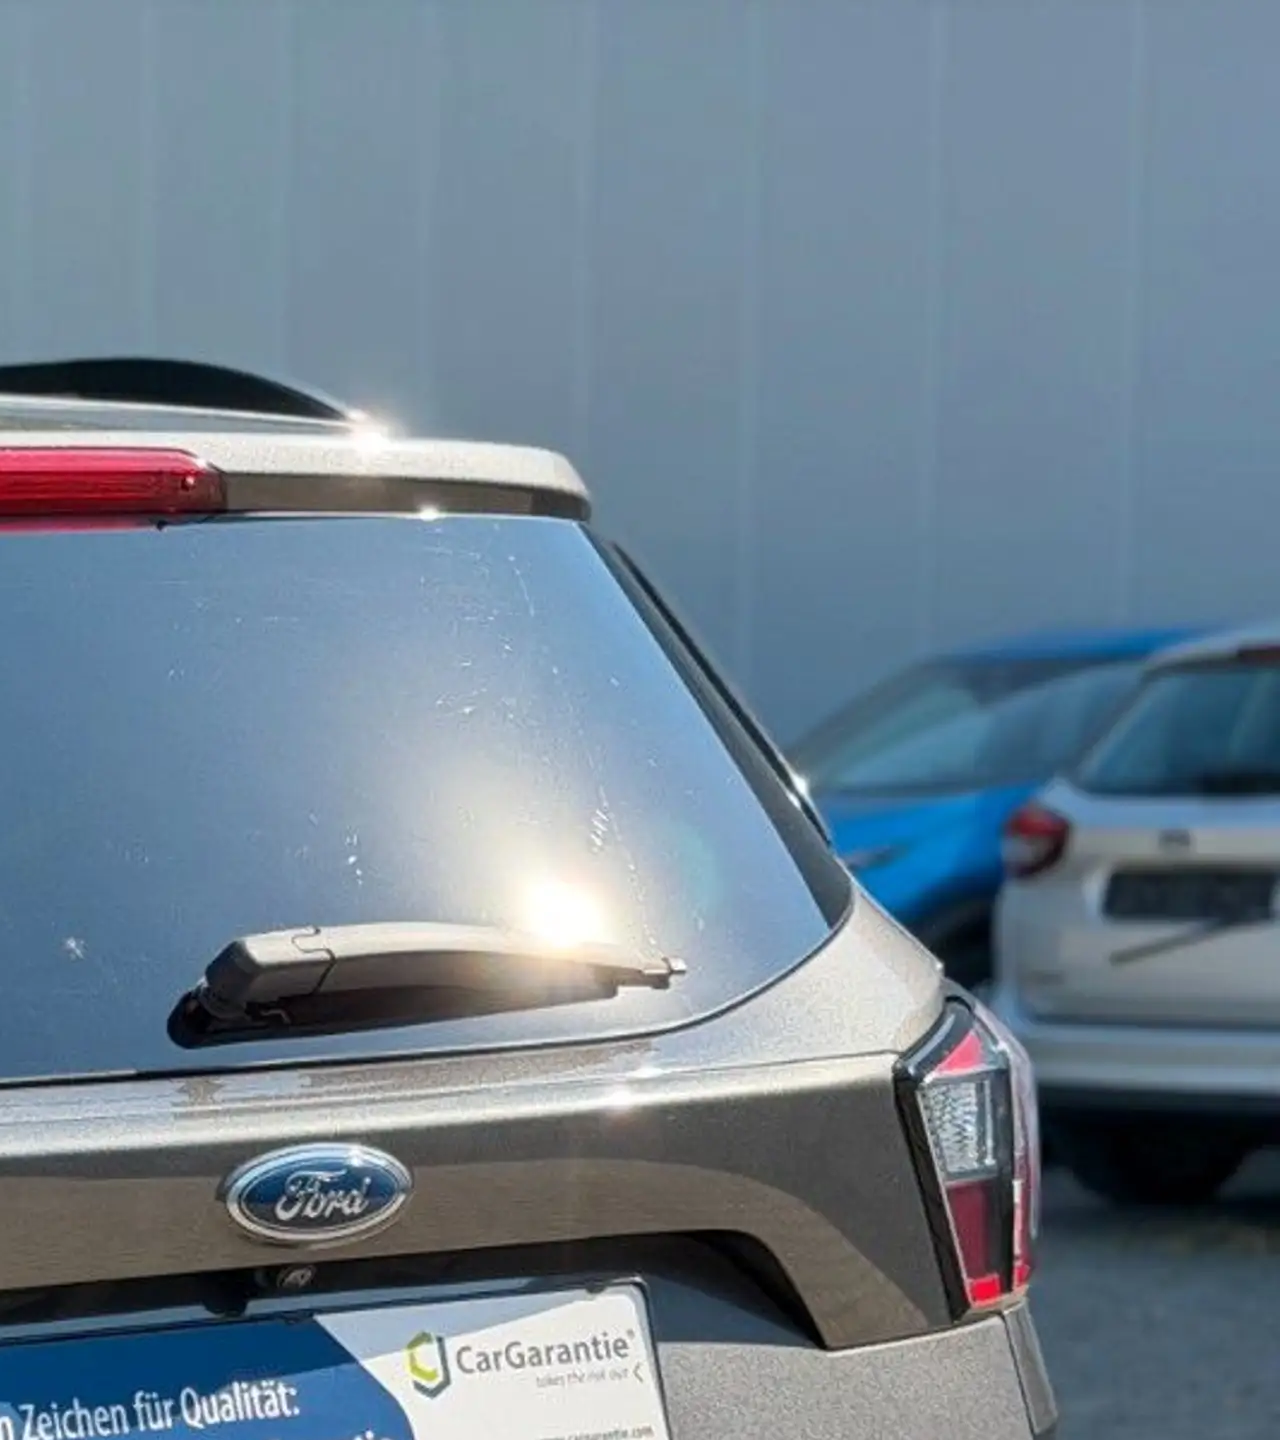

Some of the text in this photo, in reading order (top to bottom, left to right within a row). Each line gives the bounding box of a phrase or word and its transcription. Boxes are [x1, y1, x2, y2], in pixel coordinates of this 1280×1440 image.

[274, 1167, 372, 1221] Ford
[133, 1390, 174, 1432] für
[180, 1380, 301, 1429] Qualität:
